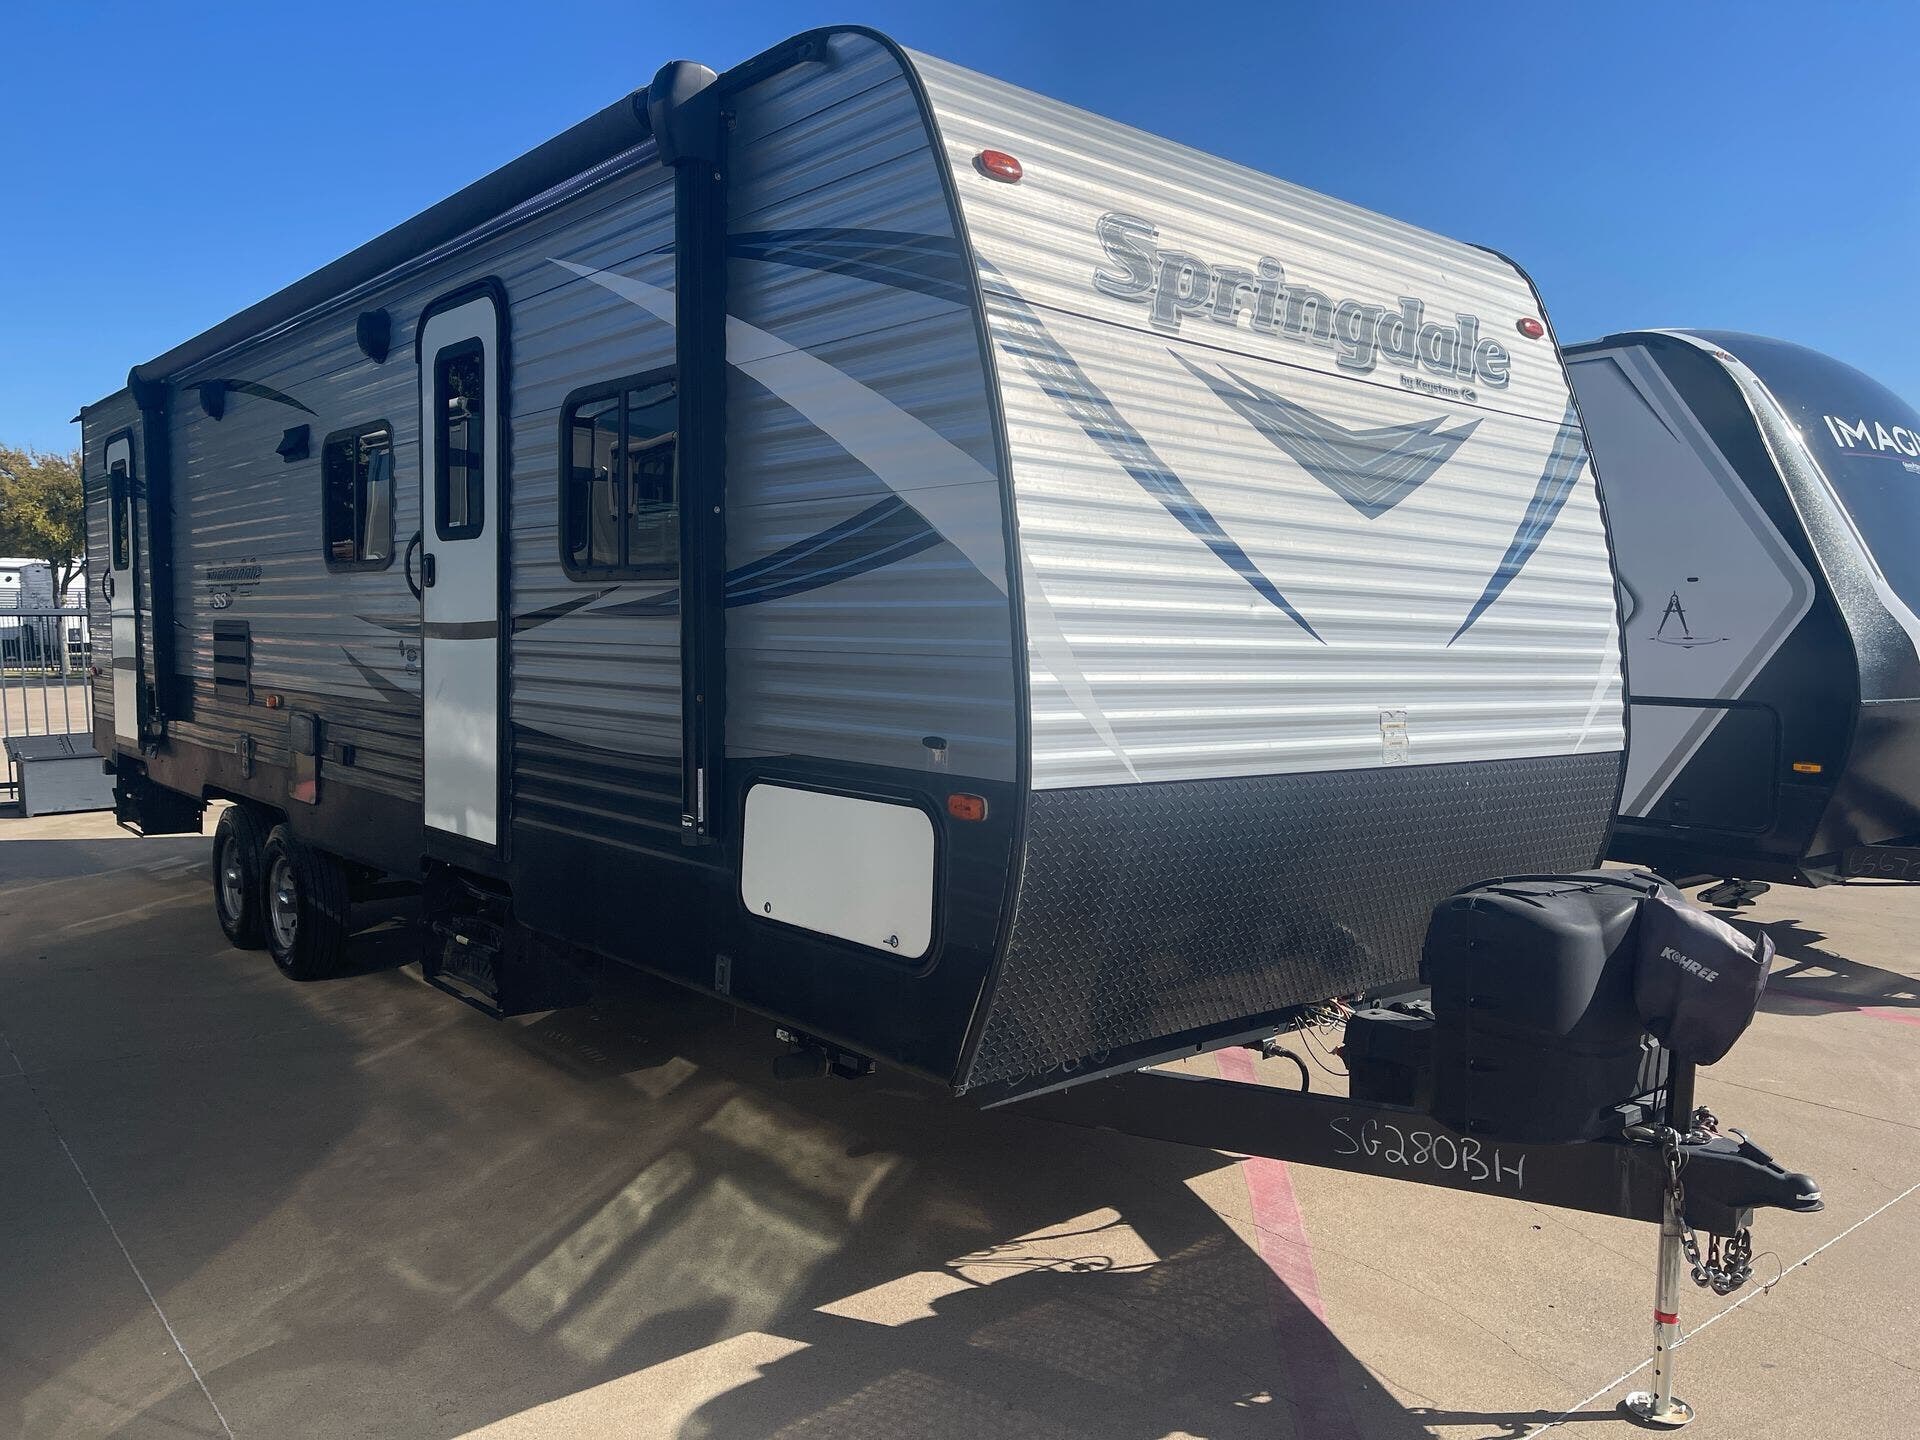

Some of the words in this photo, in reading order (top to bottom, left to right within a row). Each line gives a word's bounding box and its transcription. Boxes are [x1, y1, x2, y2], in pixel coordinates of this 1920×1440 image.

[1092, 211, 1512, 391] Springdale
[1415, 376, 1459, 397] Keystone
[1823, 415, 1920, 456] IMAGI
[1660, 946, 1719, 982] KOHREE
[1329, 1117, 1526, 1190] SG280BH
